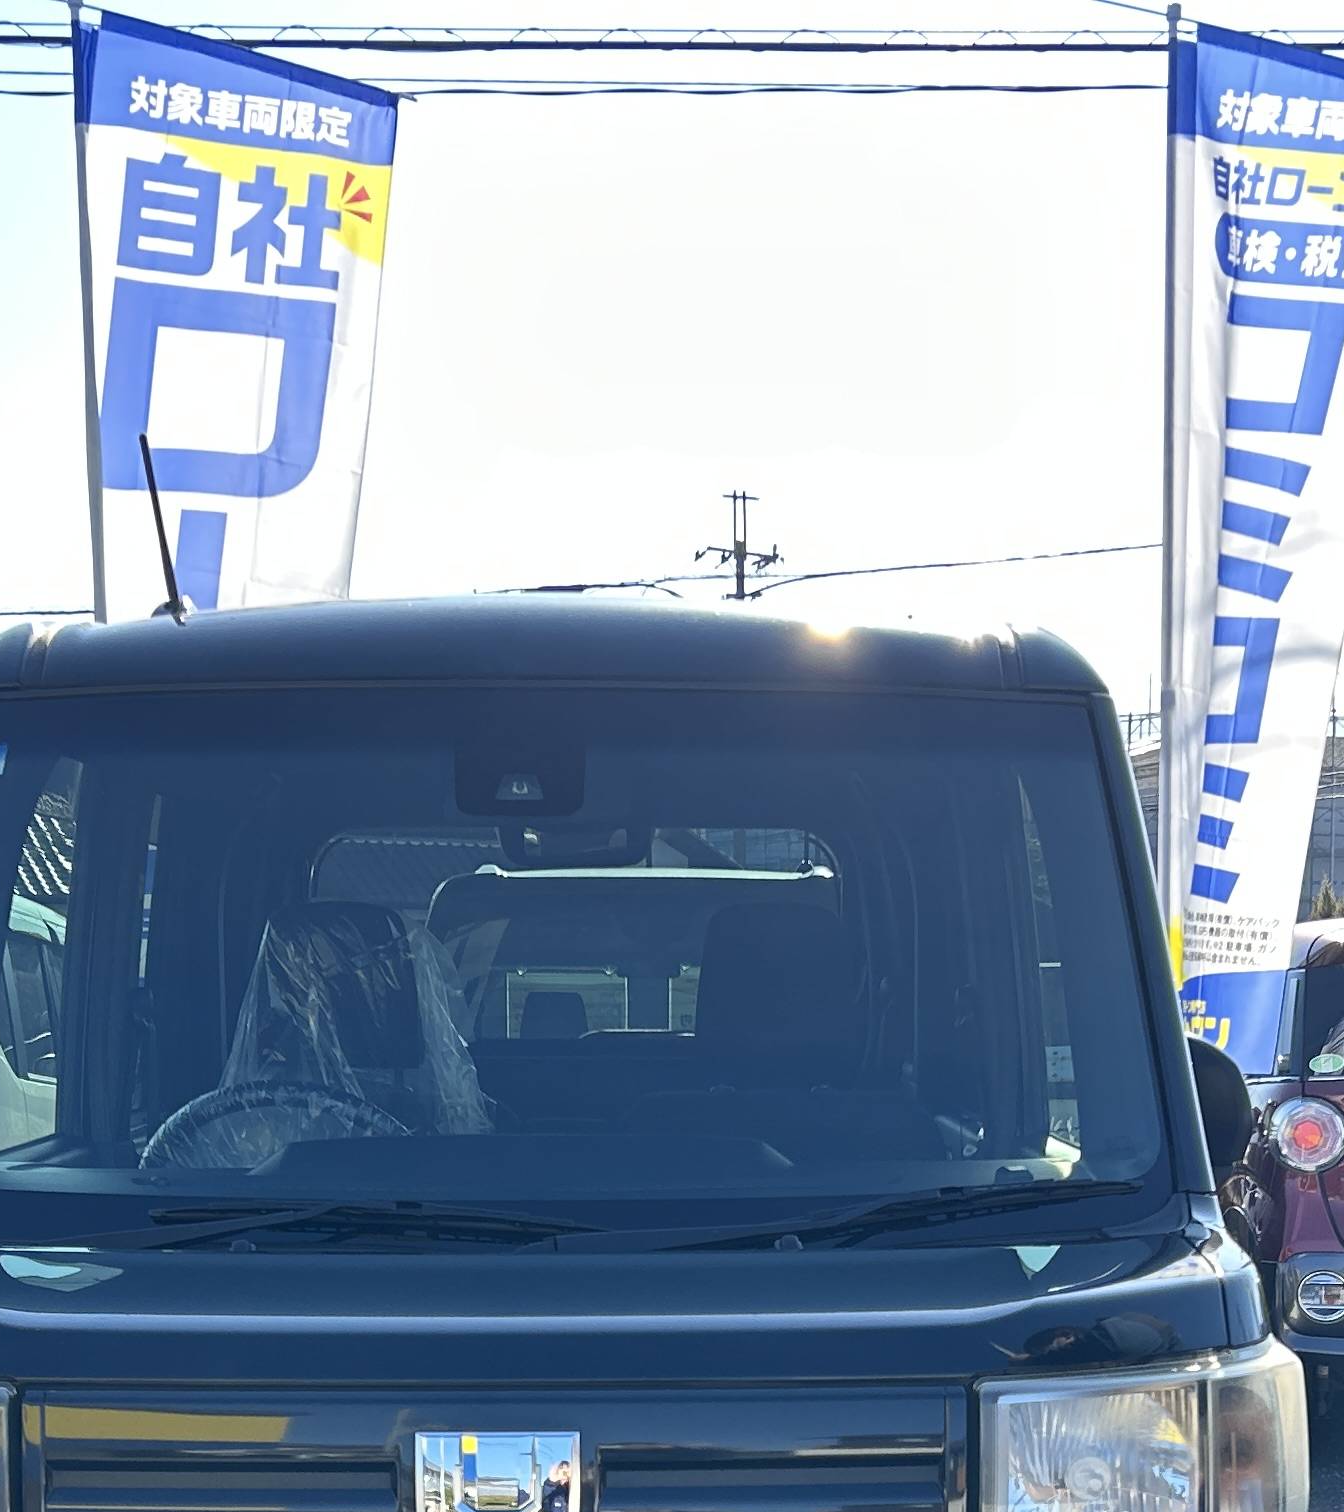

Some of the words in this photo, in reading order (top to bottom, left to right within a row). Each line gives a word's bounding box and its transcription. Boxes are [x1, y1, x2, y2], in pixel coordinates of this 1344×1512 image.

[130, 76, 353, 148] 対象車両限定
[116, 154, 342, 291] 自社
